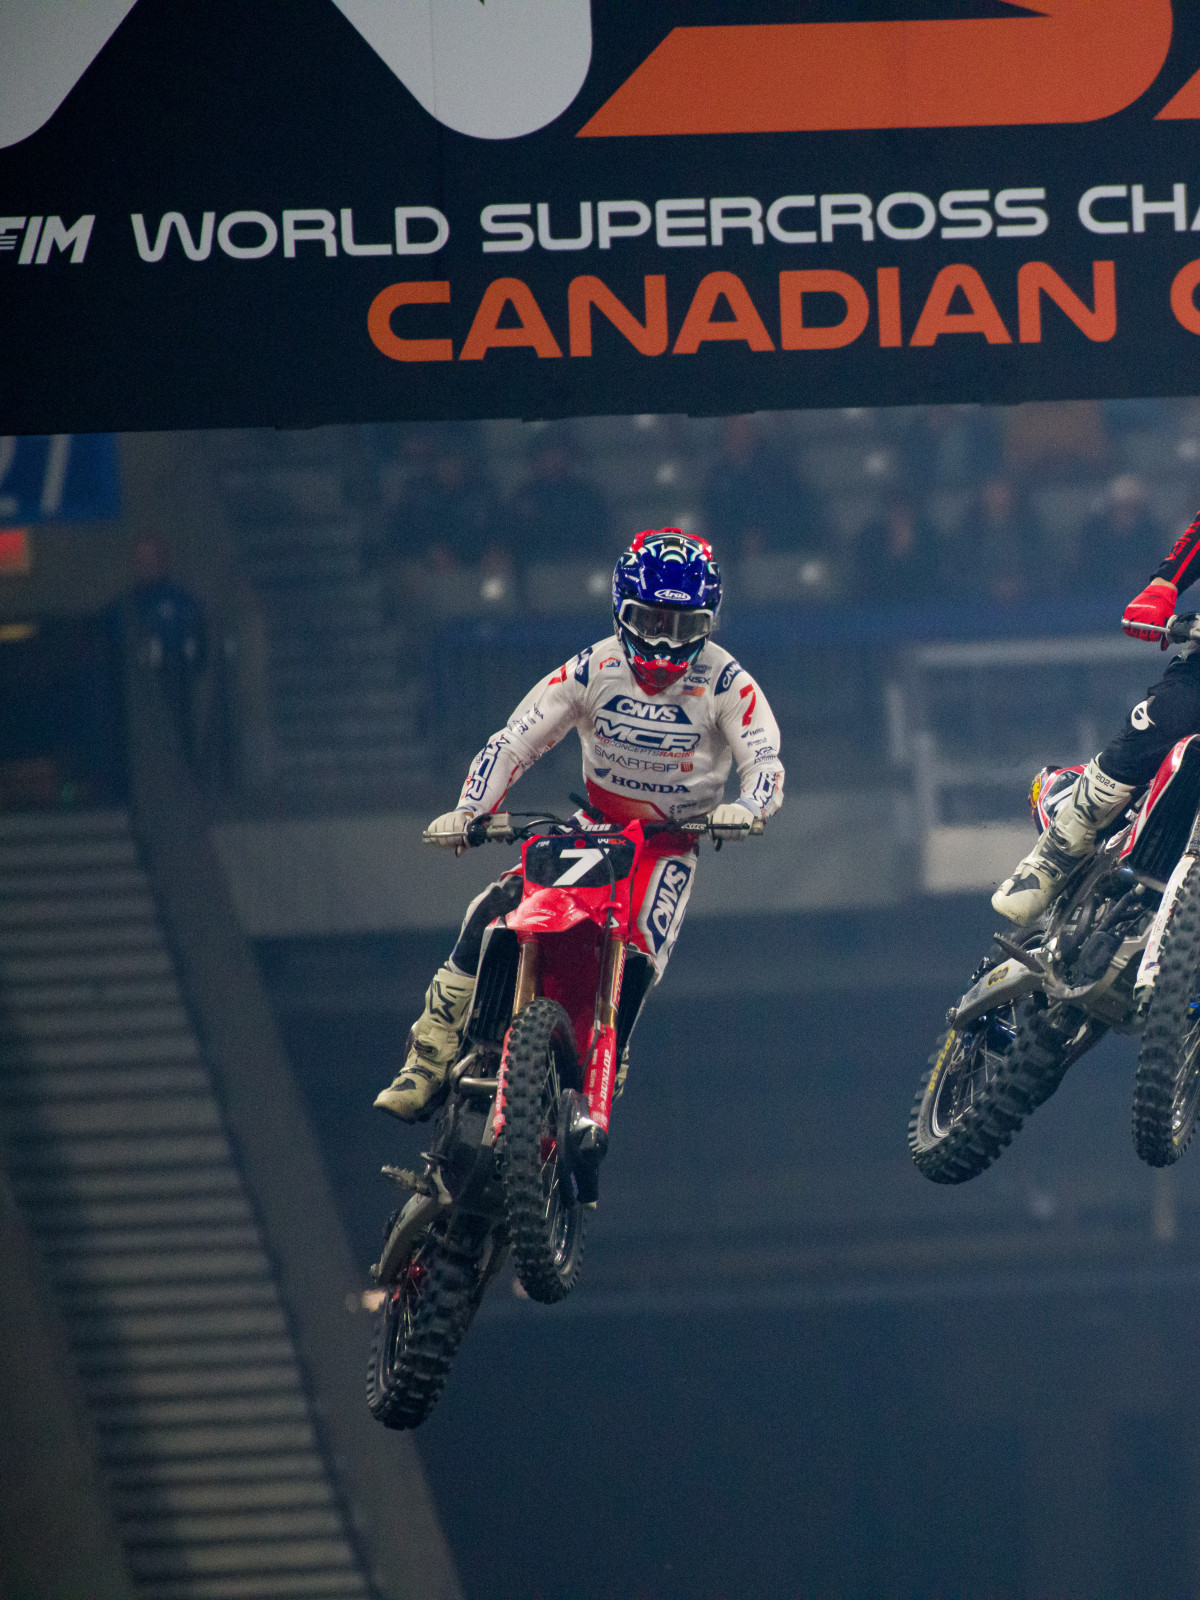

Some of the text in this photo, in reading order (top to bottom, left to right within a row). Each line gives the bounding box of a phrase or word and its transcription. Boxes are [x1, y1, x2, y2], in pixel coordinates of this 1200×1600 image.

[131, 206, 449, 262] WORLD
[480, 188, 1049, 253] SUPERCROSS
[367, 260, 1117, 363] CANADIAN
[616, 698, 679, 722] CNVS
[739, 684, 756, 727] 7
[594, 715, 701, 752] MCR
[610, 774, 691, 794] HONDA
[1095, 773, 1116, 790] 2024
[552, 848, 610, 887] 7
[652, 862, 688, 937] CNVS
[600, 1049, 611, 1101] DUNLOP
